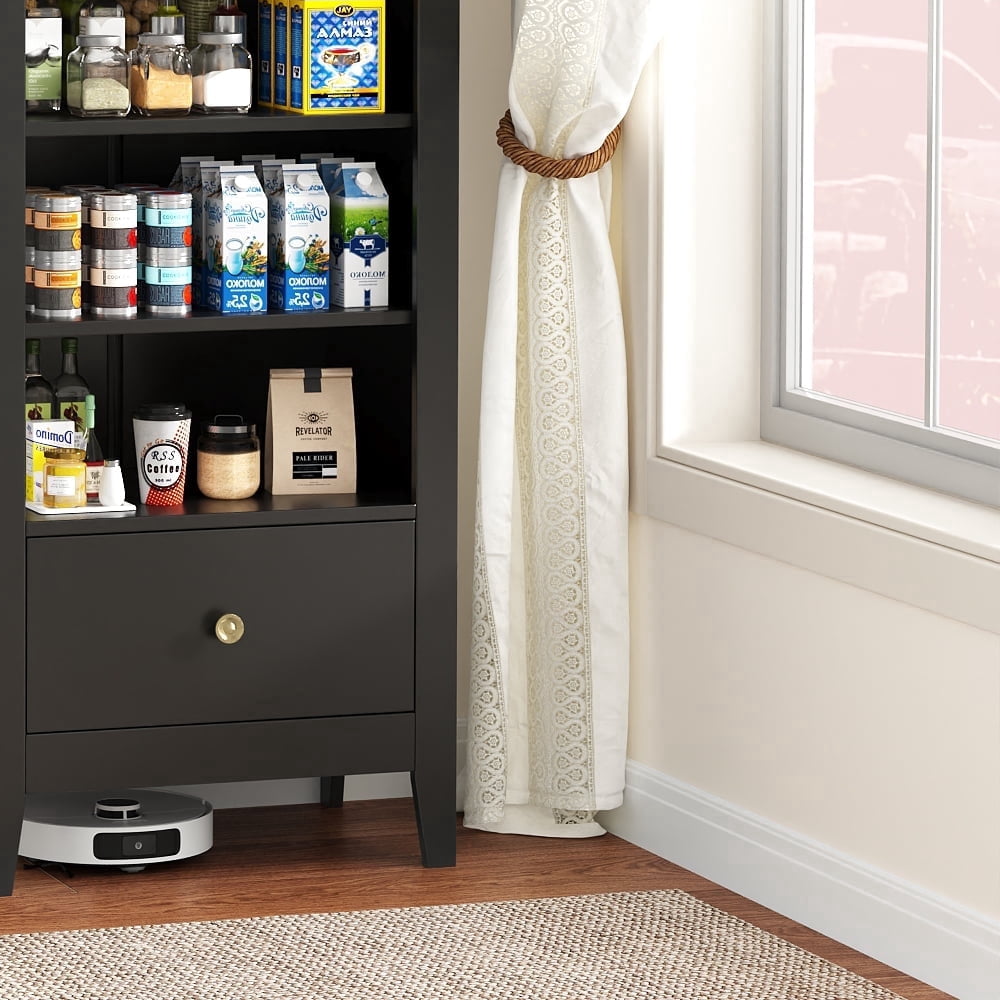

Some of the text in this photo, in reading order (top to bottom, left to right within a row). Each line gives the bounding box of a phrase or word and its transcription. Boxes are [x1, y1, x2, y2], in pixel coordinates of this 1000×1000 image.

[316, 27, 373, 39] АЛМАЗ
[295, 426, 332, 437] REVELATOR
[151, 450, 176, 462] RSS
[147, 463, 180, 474] Coffee
